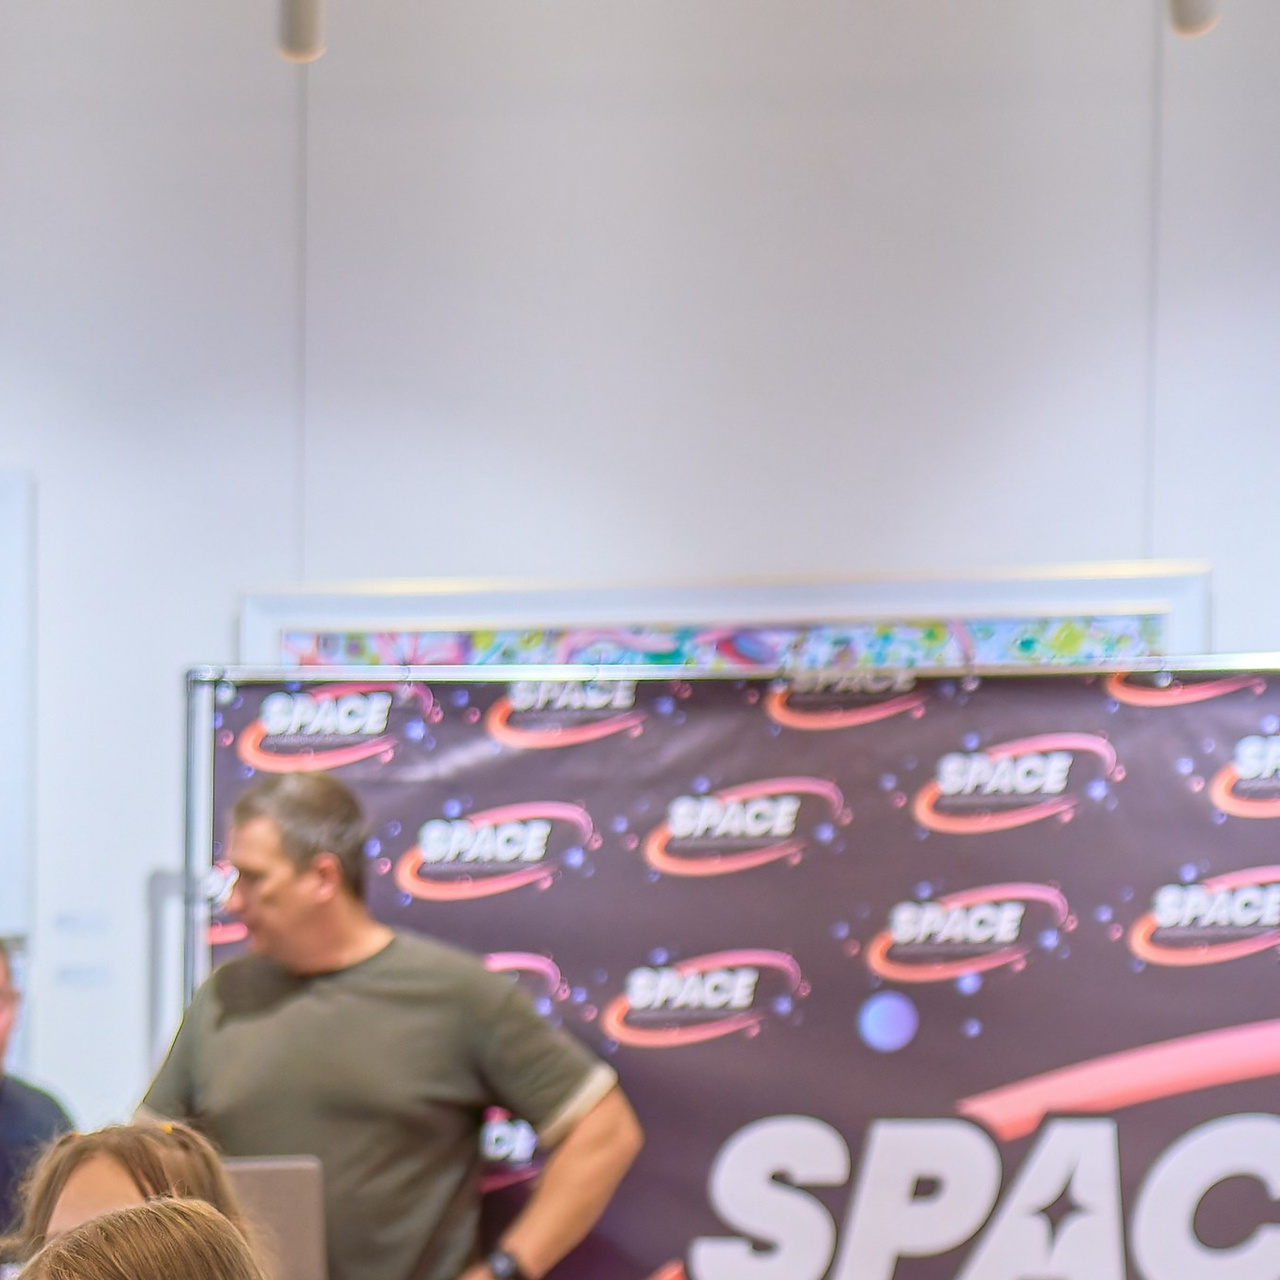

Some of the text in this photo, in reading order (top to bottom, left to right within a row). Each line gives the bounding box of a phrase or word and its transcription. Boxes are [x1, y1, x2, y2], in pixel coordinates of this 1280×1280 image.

[260, 691, 392, 736] SPACE
[937, 751, 1074, 795] SPACE
[667, 796, 801, 838] SPACE
[418, 818, 552, 864] SPACE
[889, 901, 1025, 944] SPACE
[624, 967, 759, 1010] SPACE
